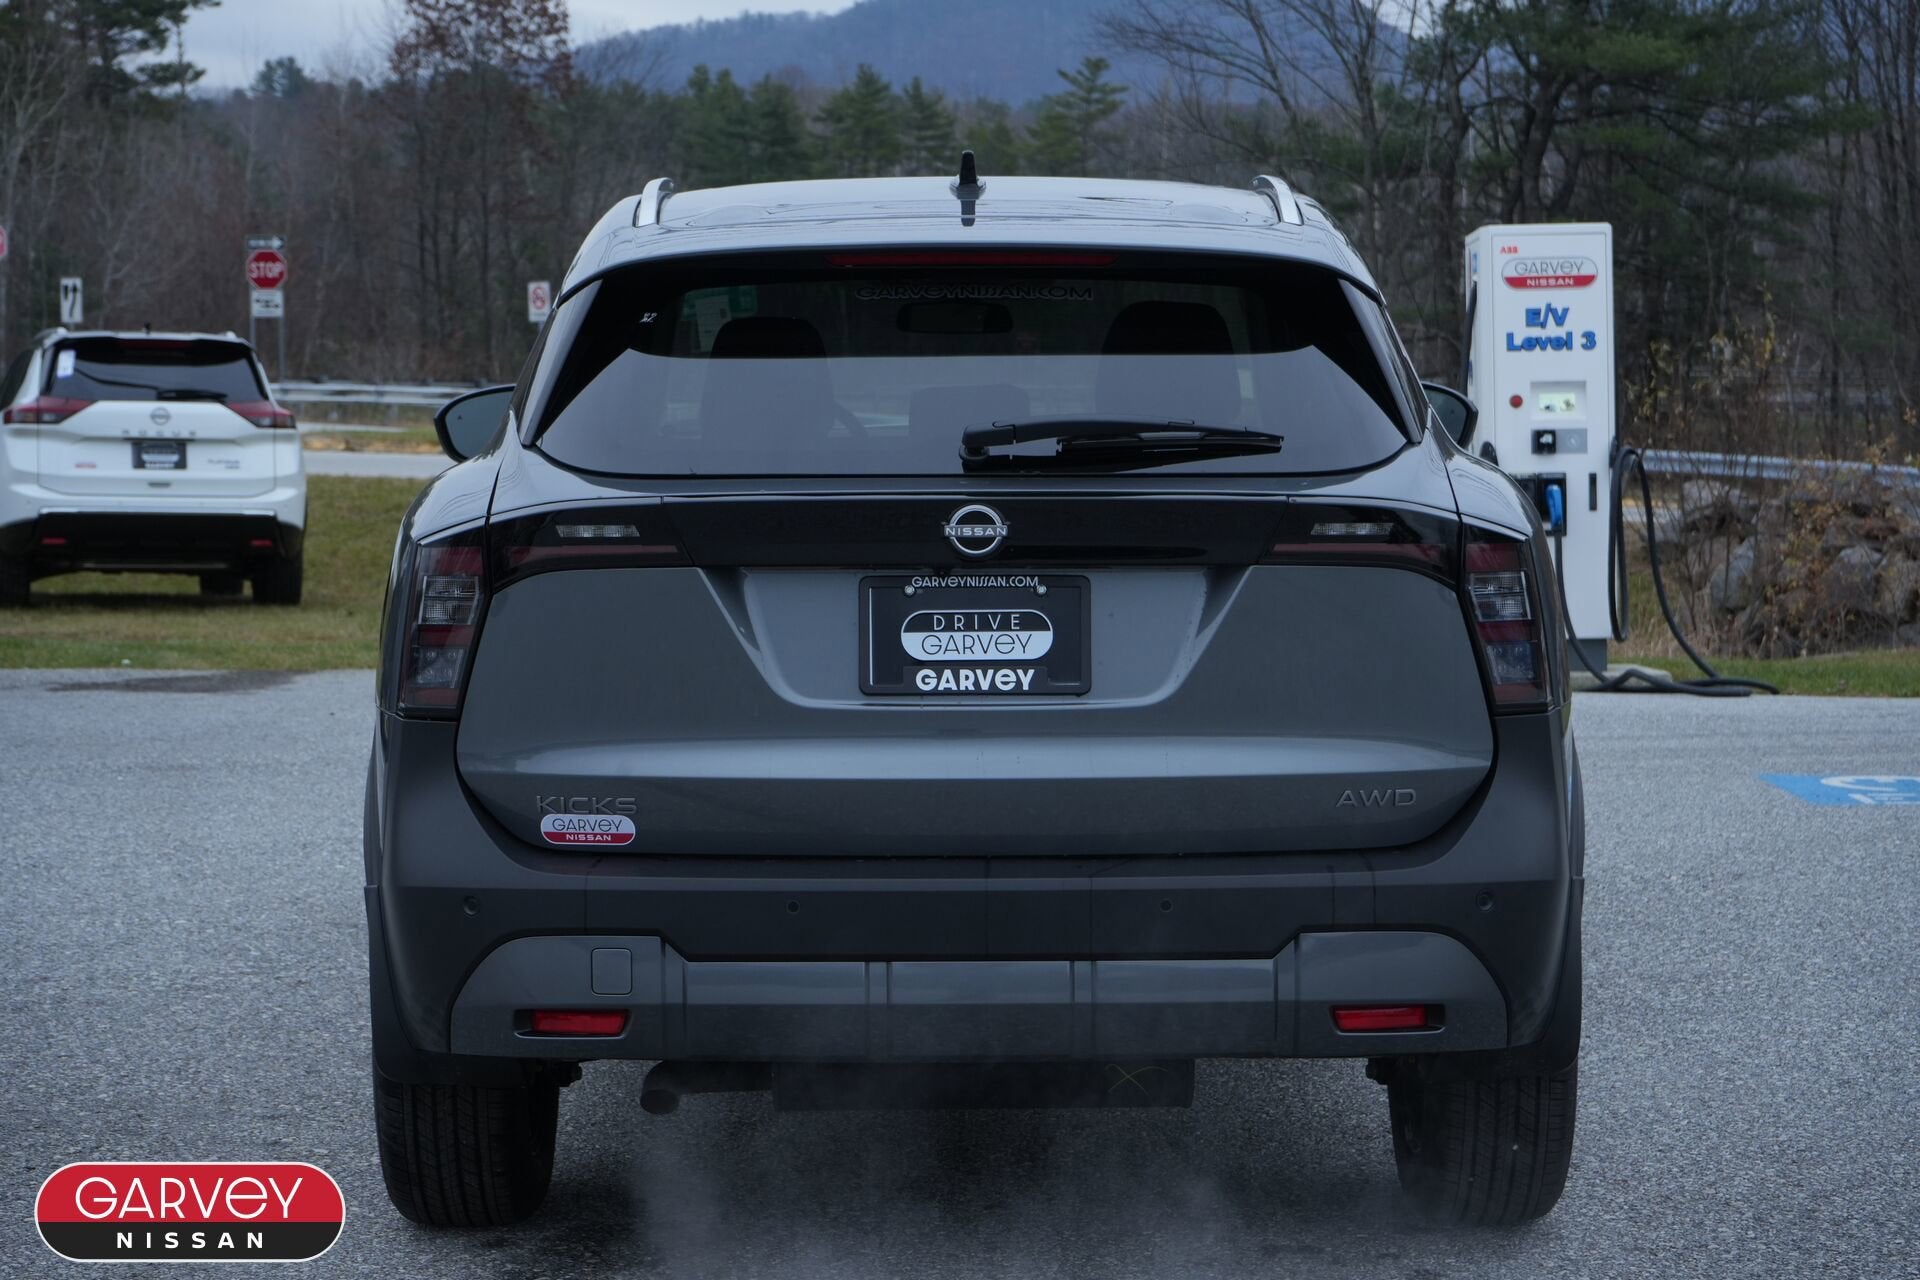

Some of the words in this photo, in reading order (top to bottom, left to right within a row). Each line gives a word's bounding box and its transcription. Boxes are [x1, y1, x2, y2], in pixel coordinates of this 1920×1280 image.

[248, 261, 285, 279] STOP
[1514, 260, 1583, 276] GARVEY
[1526, 277, 1574, 286] NISSAN
[1525, 302, 1570, 329] E/V
[1506, 331, 1573, 351] Level
[1581, 331, 1597, 350] 3
[945, 527, 1007, 536] NISSAN
[911, 576, 1039, 588] GARVEYNISSAN.COM
[933, 614, 1020, 631] DRIVE
[921, 633, 1032, 655] GARVEY
[915, 668, 1035, 691] GARVEY
[536, 795, 637, 815] KICKS
[1336, 789, 1417, 807] AWD
[551, 818, 622, 832] GARVEY
[566, 833, 612, 841] NISSAN
